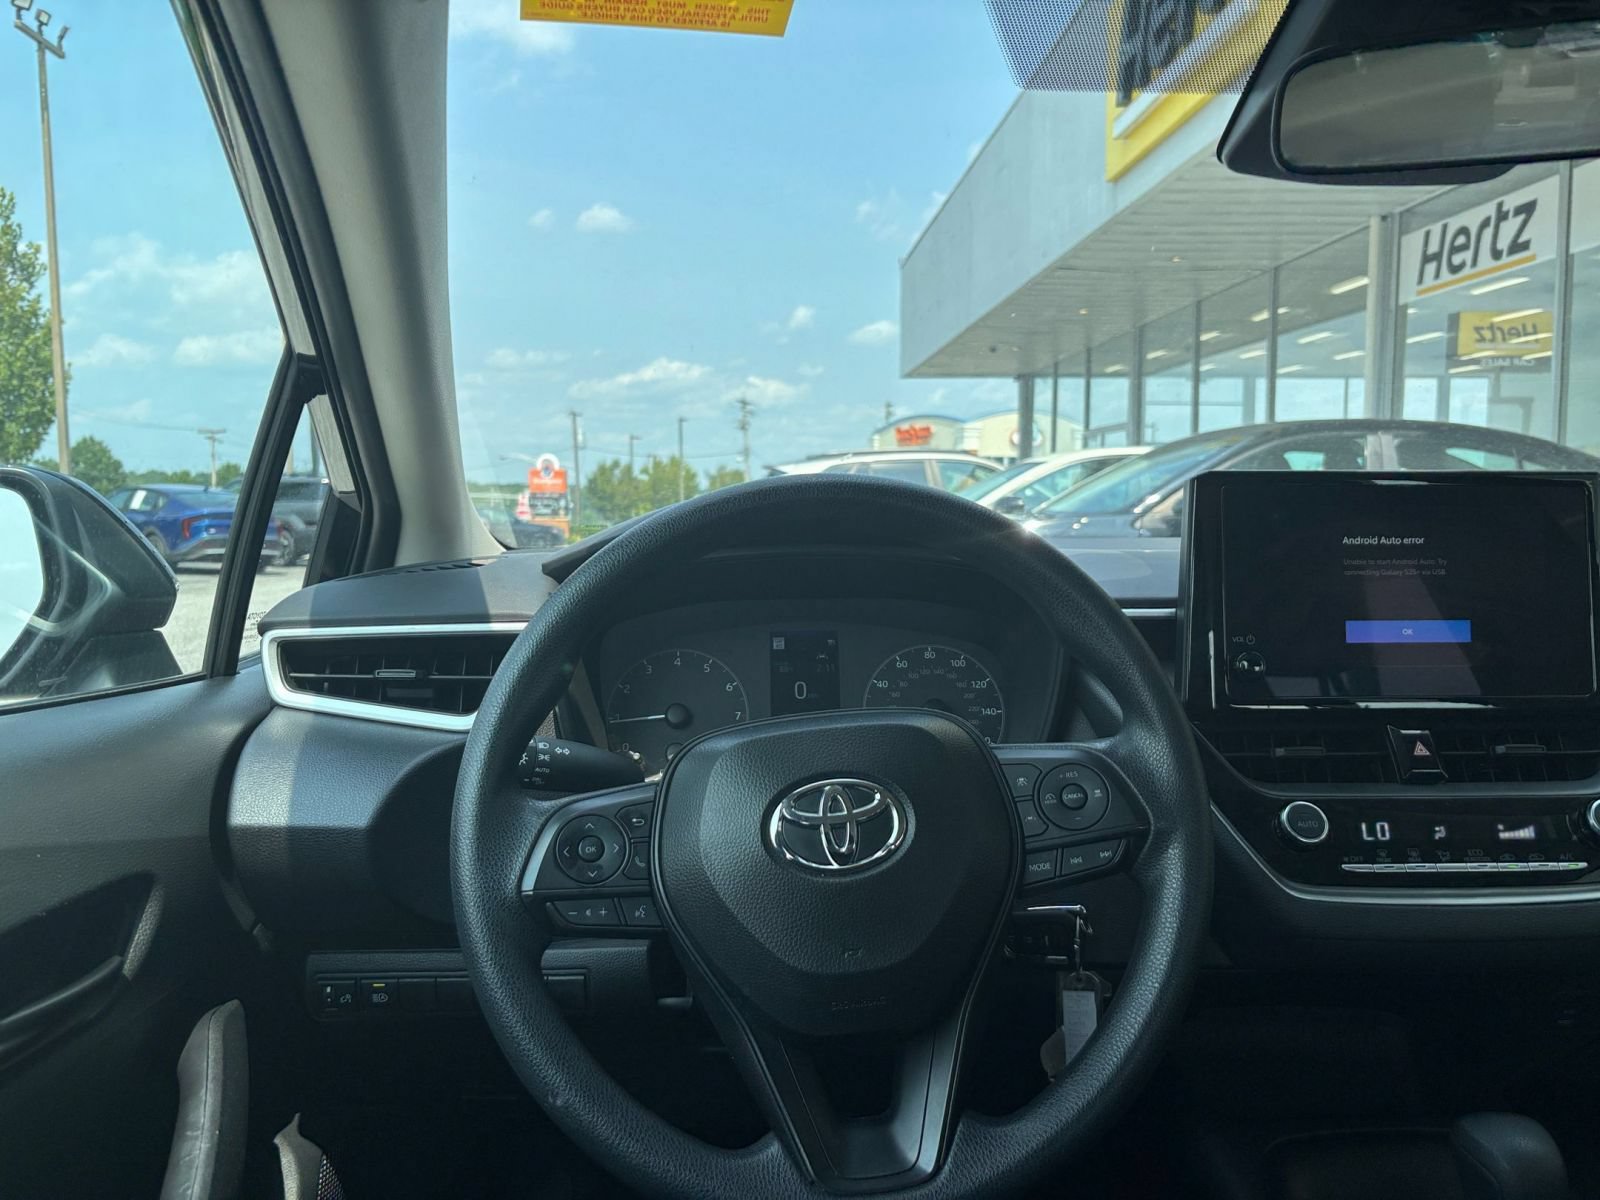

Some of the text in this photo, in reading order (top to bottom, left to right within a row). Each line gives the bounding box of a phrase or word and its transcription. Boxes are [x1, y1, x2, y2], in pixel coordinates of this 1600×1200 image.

[1416, 197, 1538, 286] Hertz
[1342, 536, 1425, 545] Android Auto error
[1391, 558, 1418, 566] Android
[924, 651, 936, 659] 80
[673, 657, 682, 666] 4
[896, 660, 908, 668] 60
[950, 659, 966, 668] 100
[645, 664, 653, 675] 3
[704, 663, 712, 673] 5
[725, 682, 734, 692] 6
[876, 680, 889, 688] 40
[970, 680, 987, 689] 120
[623, 684, 631, 694] 2
[794, 681, 807, 699] 0
[734, 711, 742, 720] 7
[980, 707, 997, 716] 140
[622, 742, 630, 752] 0
[1297, 820, 1319, 828] AUTO
[1360, 821, 1391, 841] LO
[585, 846, 598, 854] OK
[1028, 861, 1052, 873] MODE
